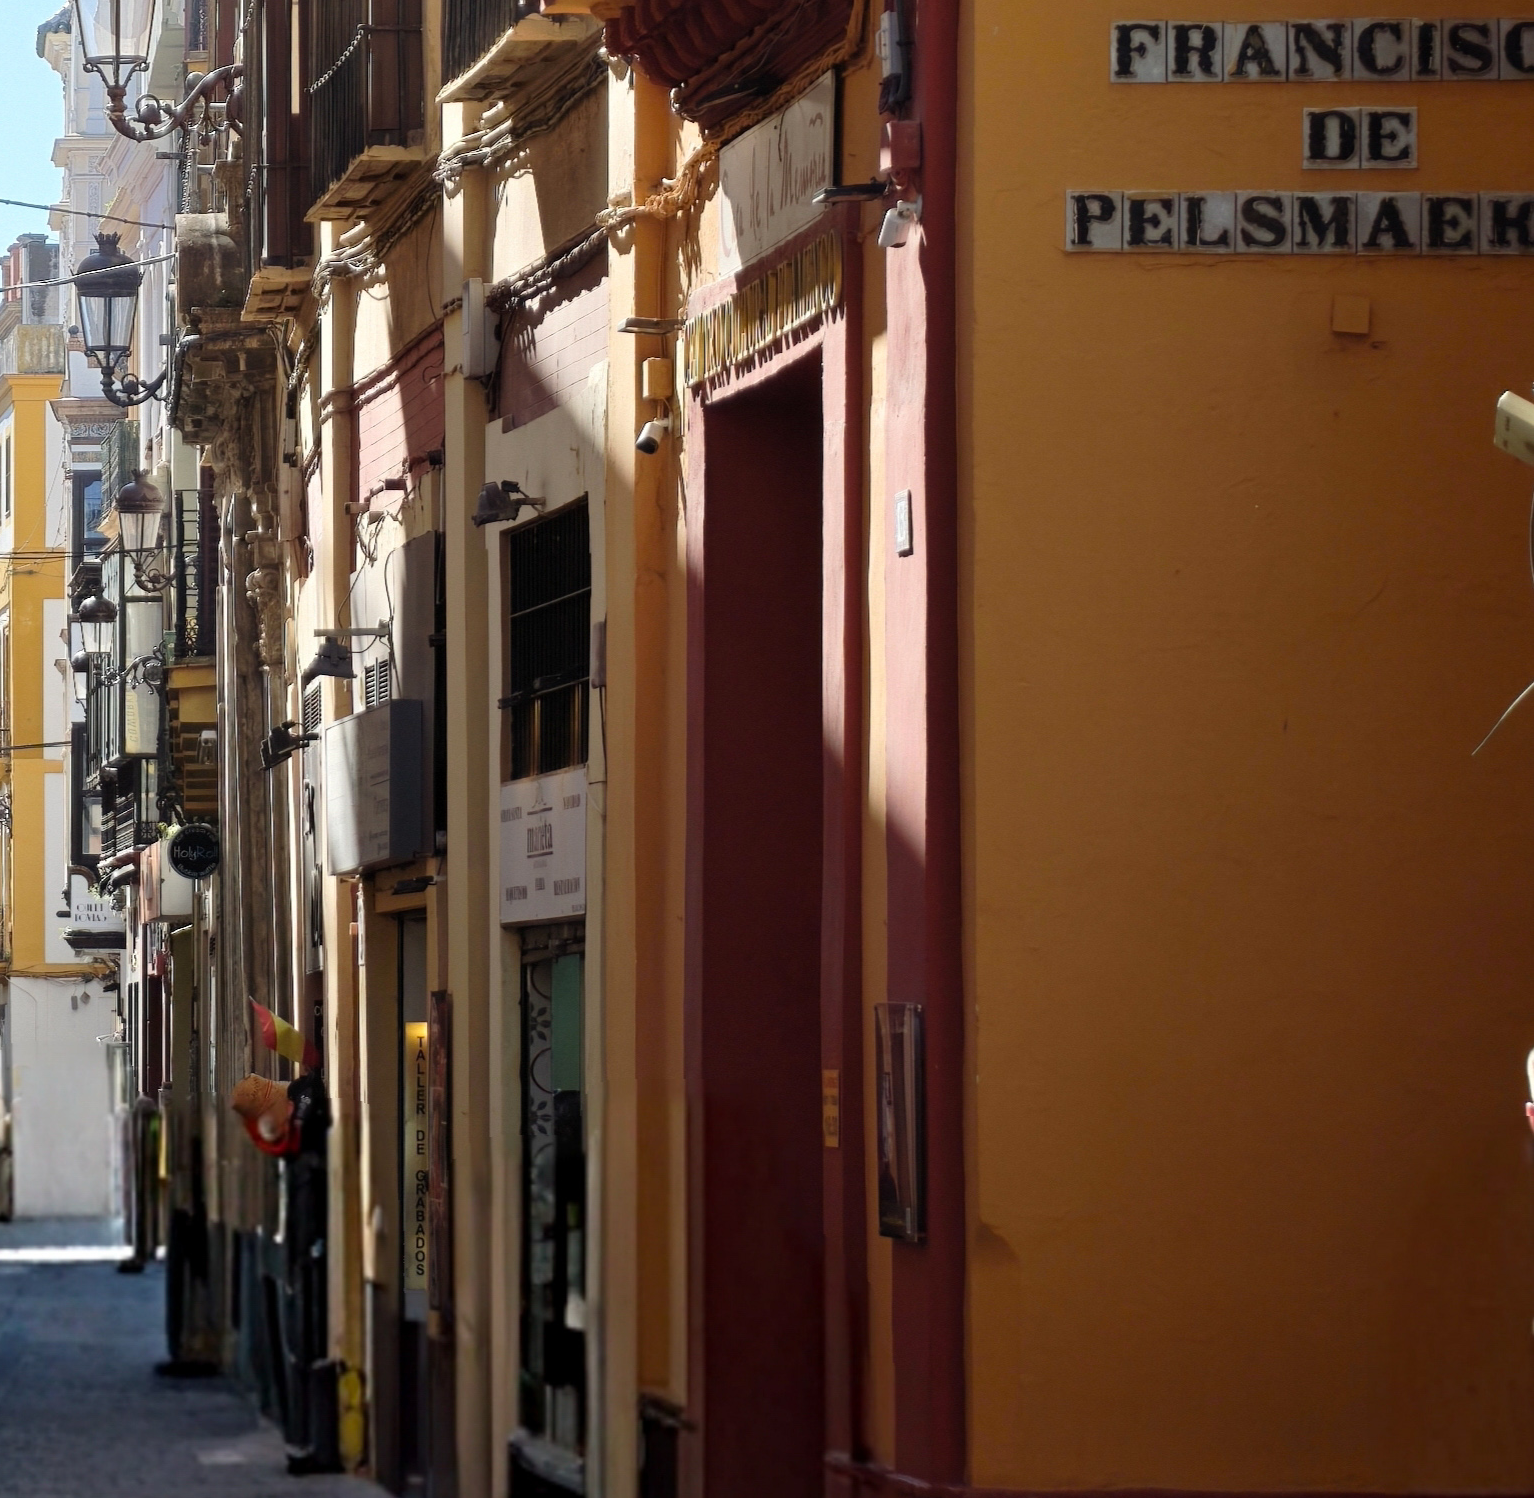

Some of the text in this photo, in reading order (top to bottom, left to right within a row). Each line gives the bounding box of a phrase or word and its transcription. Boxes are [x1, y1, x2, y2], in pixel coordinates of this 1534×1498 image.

[1306, 109, 1412, 162] DE
[415, 1036, 427, 1276] TALLER DE GRABADOS
